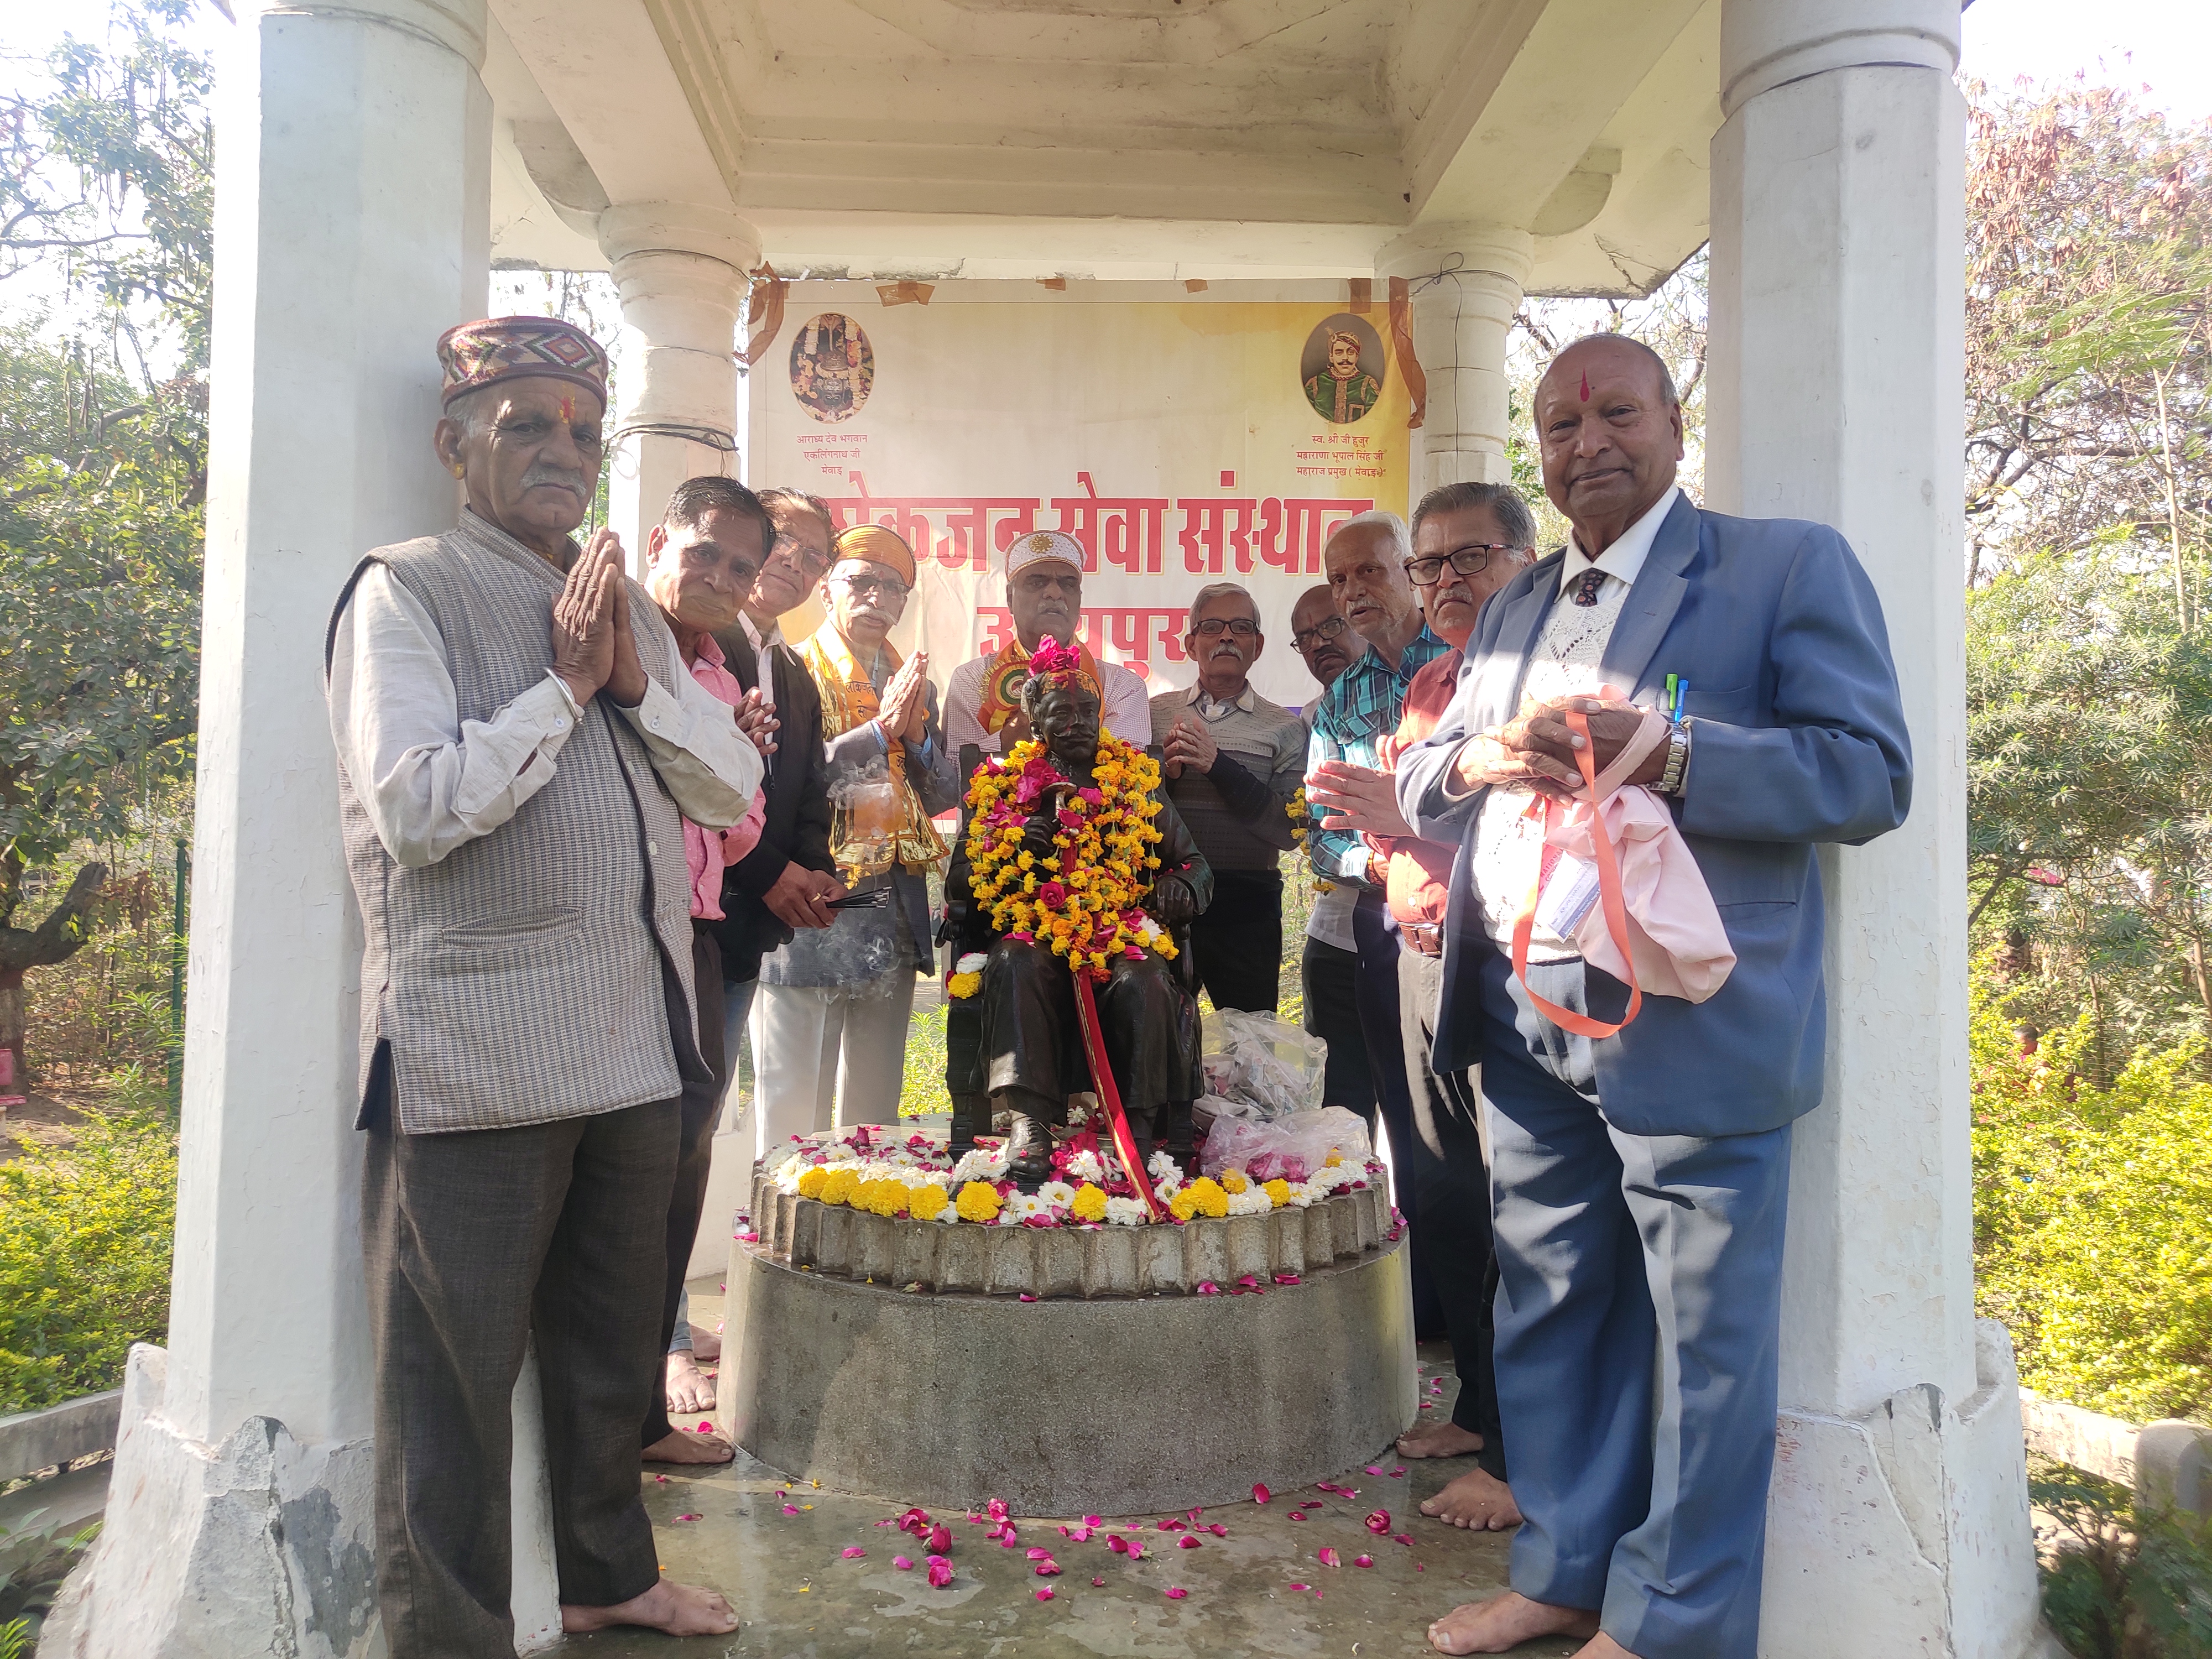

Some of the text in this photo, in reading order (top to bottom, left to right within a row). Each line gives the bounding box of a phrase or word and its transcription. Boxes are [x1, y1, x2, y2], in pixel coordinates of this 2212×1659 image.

[796, 432, 868, 444] आराध्य देव भगवान
[1328, 432, 1339, 444] श्री
[1340, 433, 1350, 444] जी
[803, 448, 861, 462] एकलिंगनाथ जी
[1296, 450, 1385, 463] महाराणा भूपाल सिंह जी
[1296, 467, 1326, 477] महाराज
[1327, 467, 1347, 479] प्रमुख
[1051, 471, 1169, 572] सेवा
